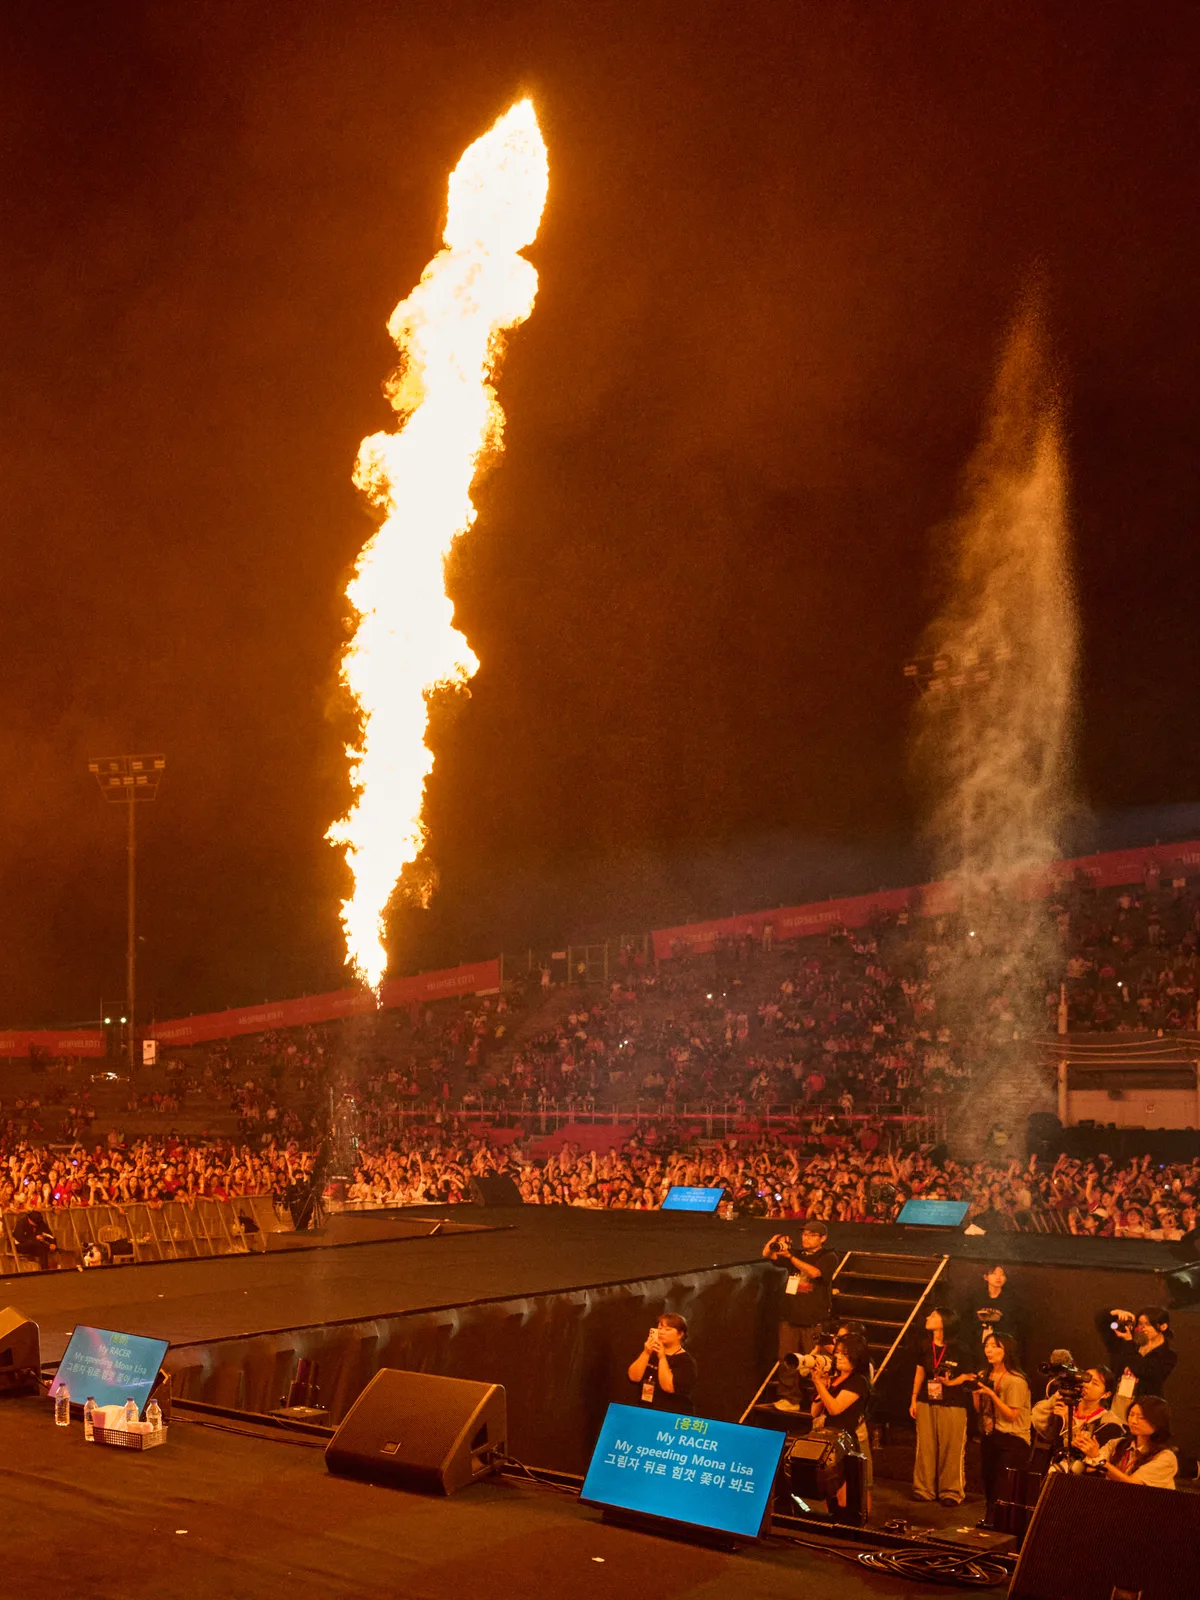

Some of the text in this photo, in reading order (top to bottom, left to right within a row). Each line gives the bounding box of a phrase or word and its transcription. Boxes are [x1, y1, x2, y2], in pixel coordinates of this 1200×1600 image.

[109, 1346, 132, 1358] RACER
[114, 1359, 133, 1371] Mona
[134, 1364, 147, 1375] Lisa
[674, 1417, 709, 1435] [용화]
[656, 1430, 719, 1452] My RACER
[614, 1439, 754, 1476] My speeding Mona Lisa
[603, 1453, 640, 1471] 그림자
[643, 1460, 667, 1475] 뒤로
[671, 1465, 697, 1483] 힘껏
[728, 1478, 755, 1494] 봐도
